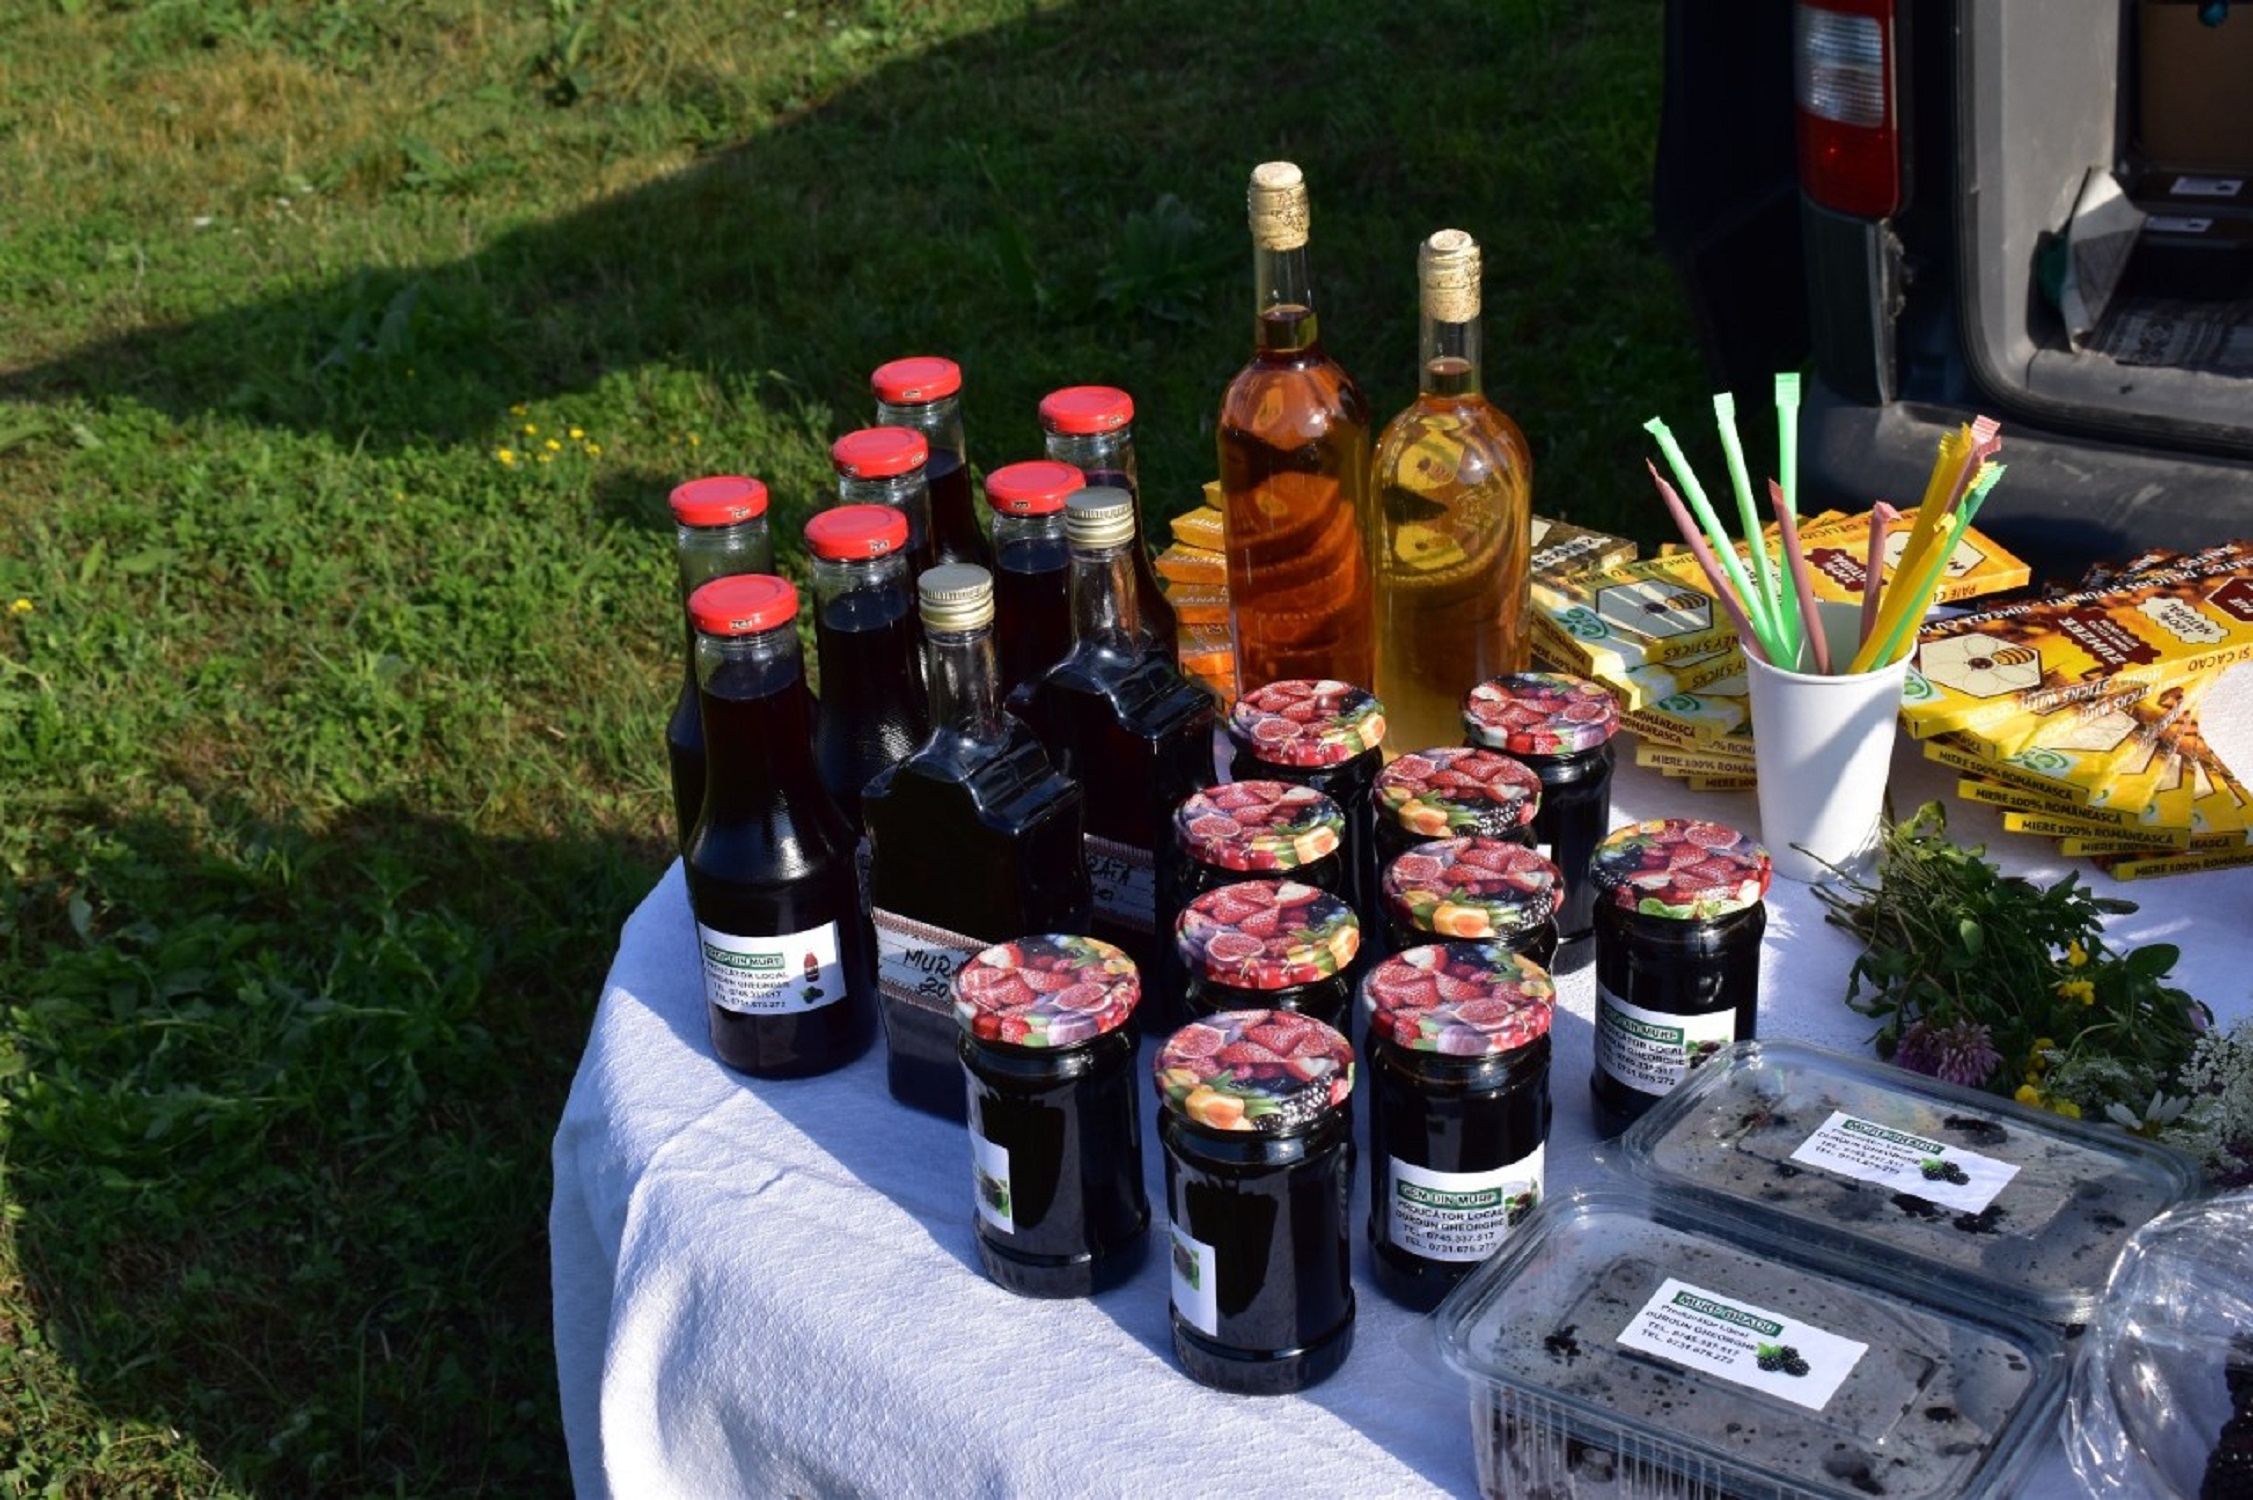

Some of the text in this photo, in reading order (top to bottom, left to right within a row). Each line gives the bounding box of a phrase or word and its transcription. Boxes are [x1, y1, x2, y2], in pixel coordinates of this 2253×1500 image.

[2188, 651, 2235, 672] CACAO
[2062, 679, 2111, 700] STICKS
[1651, 754, 1685, 767] MIERE
[2022, 820, 2057, 834] MIERE
[1466, 1208, 1503, 1221] LOCAL
